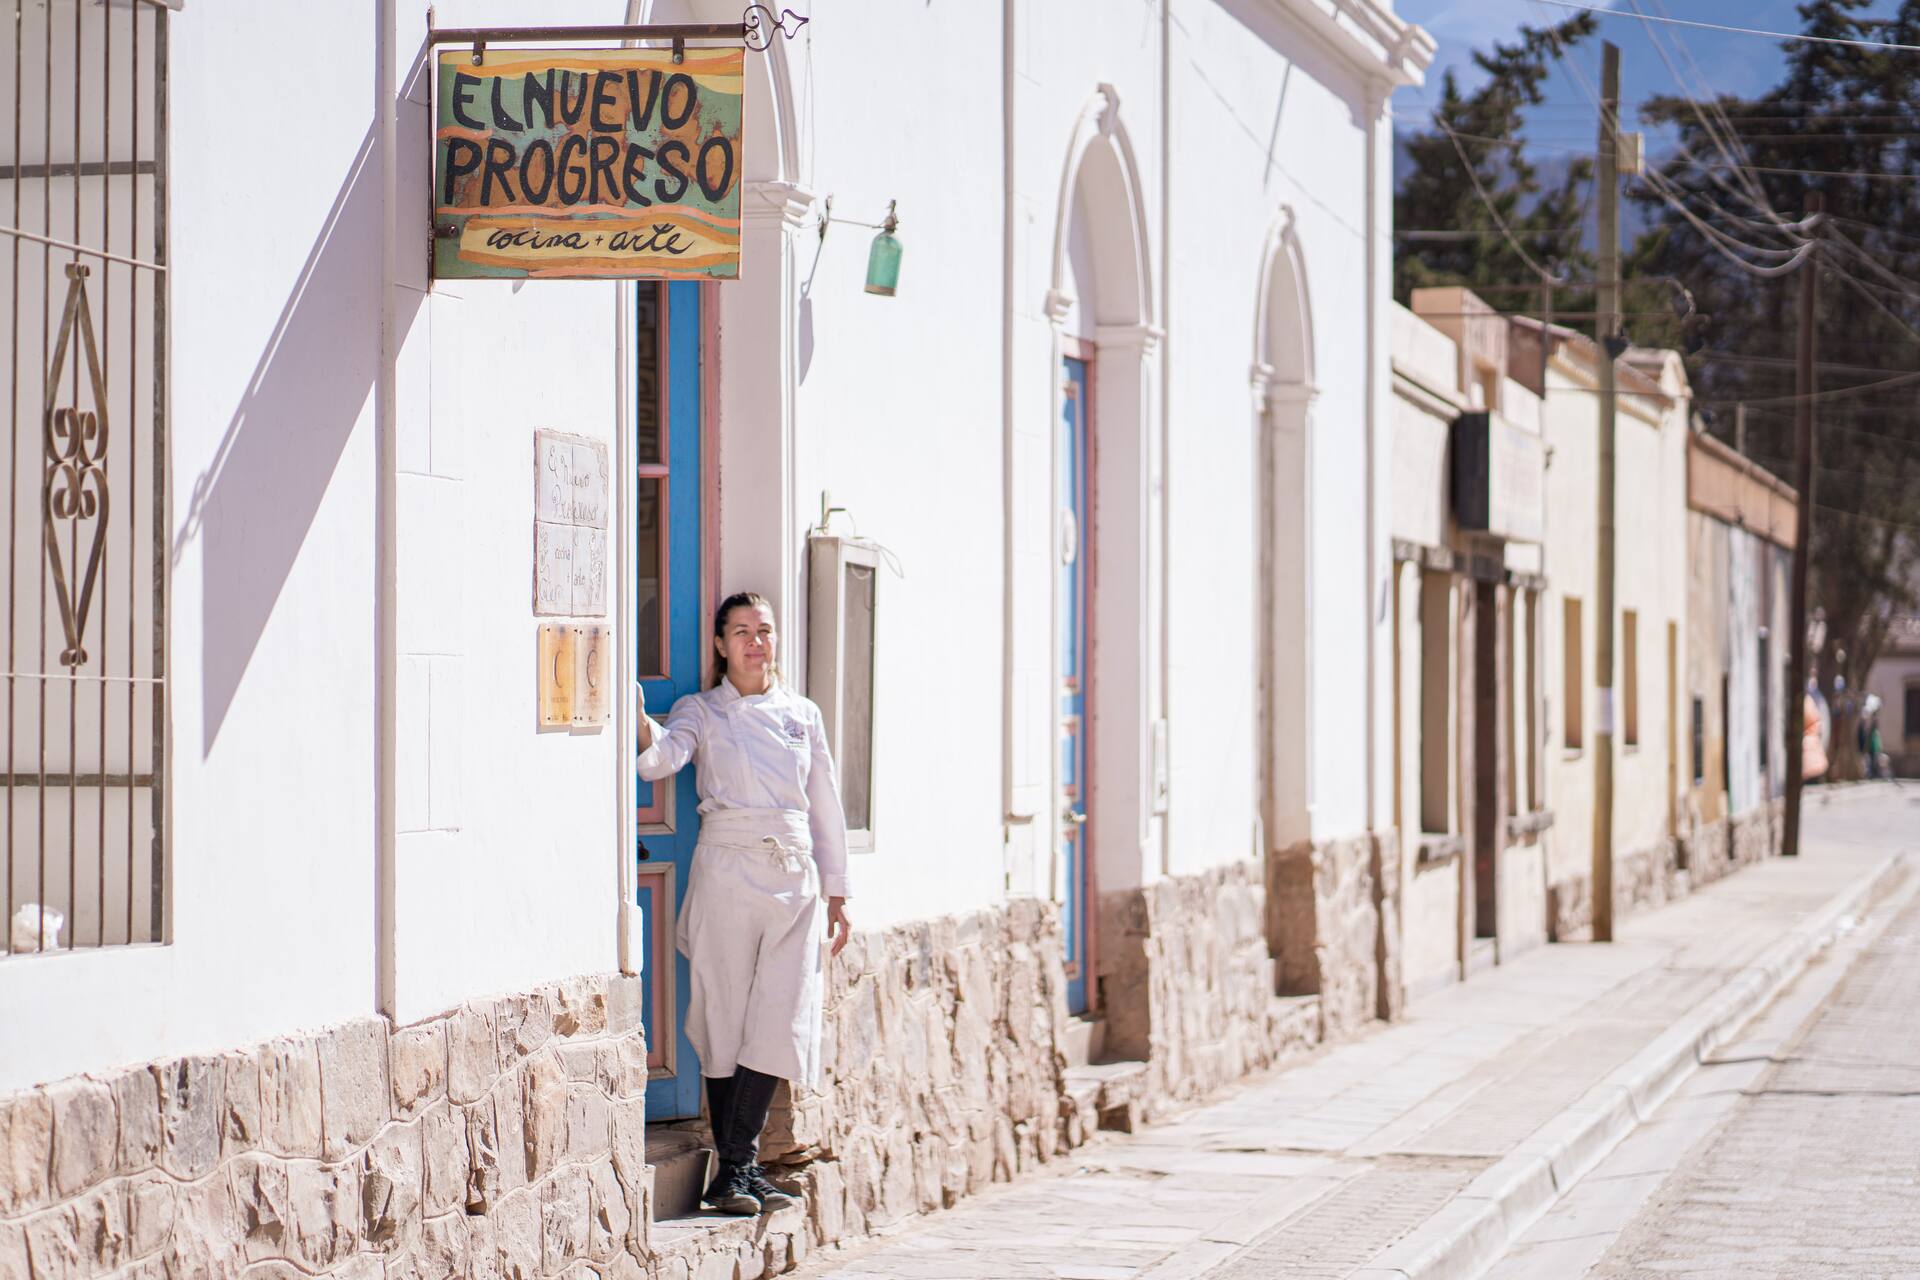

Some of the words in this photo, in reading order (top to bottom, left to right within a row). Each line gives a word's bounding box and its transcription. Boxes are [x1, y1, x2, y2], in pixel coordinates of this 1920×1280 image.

[452, 72, 523, 132] EL
[523, 68, 698, 132] NUEVO
[444, 134, 734, 207] PROGRESO
[486, 227, 589, 250] cocina
[608, 223, 695, 254] arte
